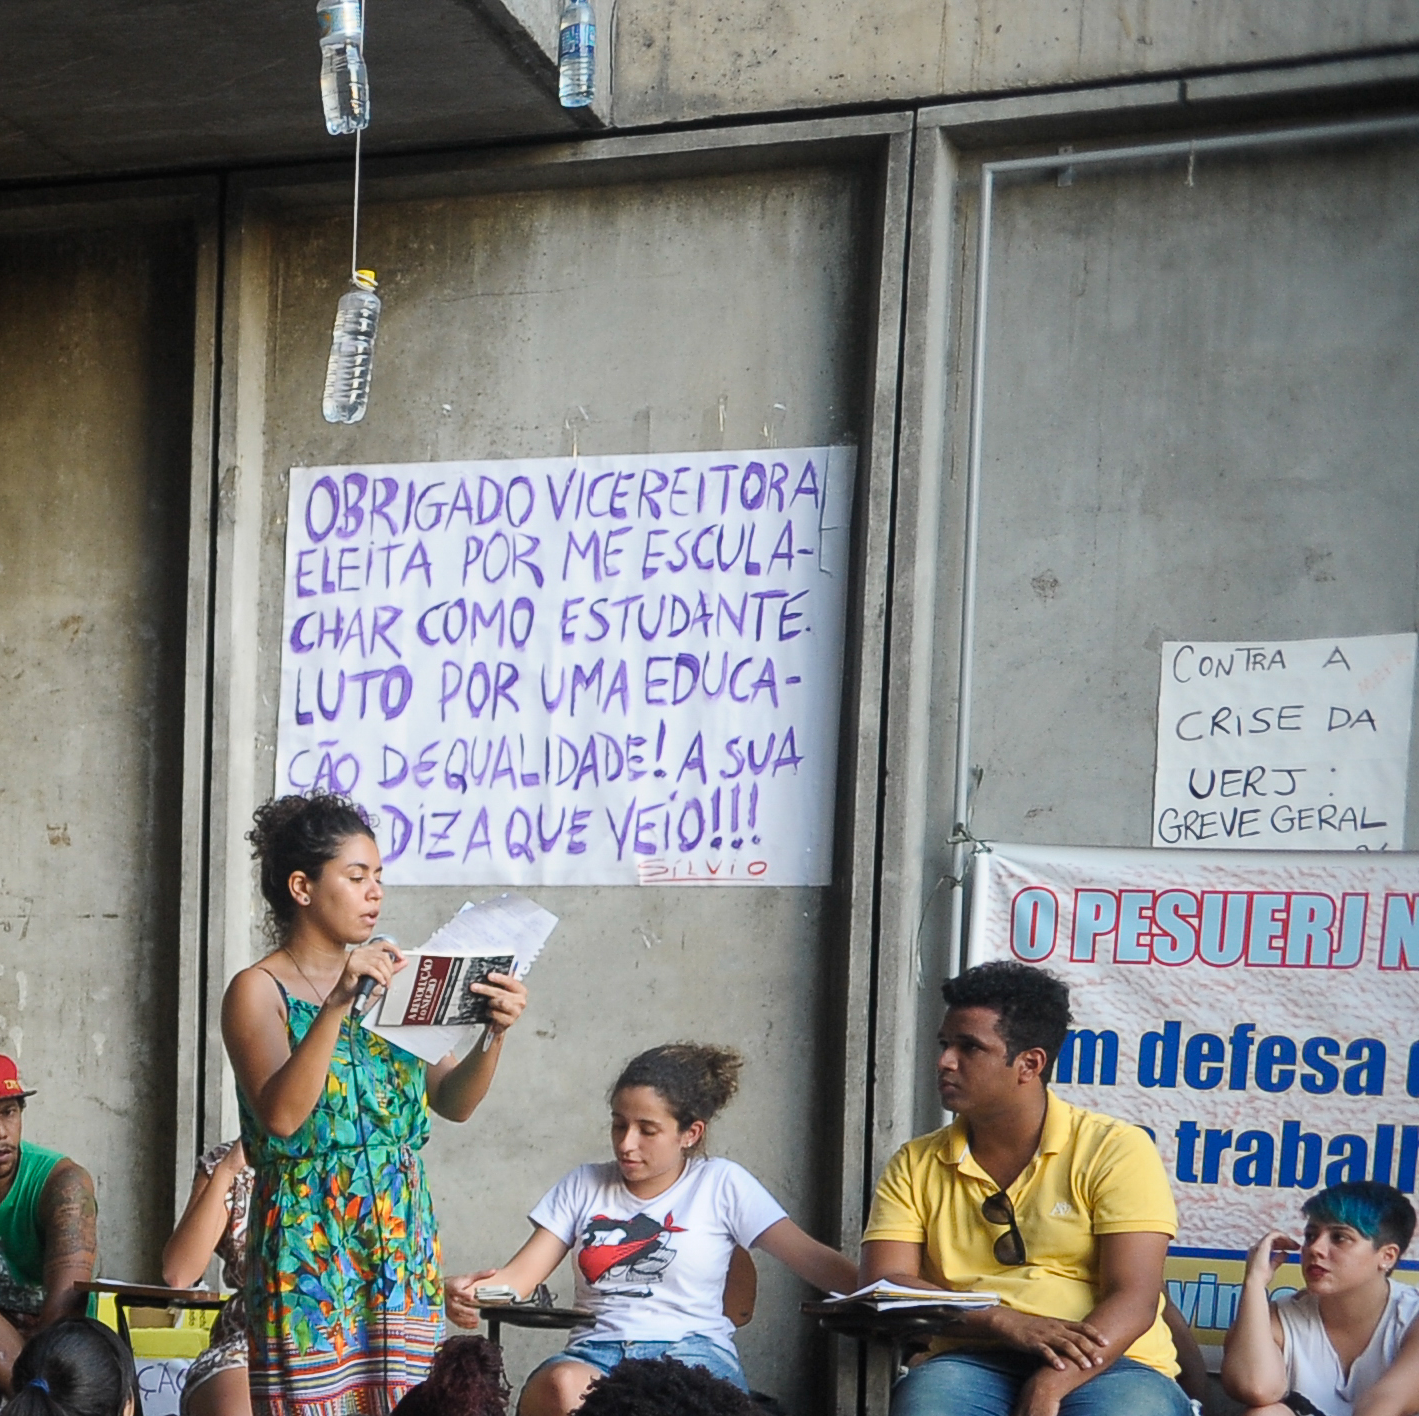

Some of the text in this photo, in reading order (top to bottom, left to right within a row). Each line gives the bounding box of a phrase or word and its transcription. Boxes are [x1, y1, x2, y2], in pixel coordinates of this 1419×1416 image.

[304, 472, 536, 542] OBRIGADO
[296, 536, 433, 600] ELEITA
[463, 533, 544, 588] POR
[563, 528, 634, 583] ME
[289, 604, 403, 658] CHAR
[417, 597, 535, 648] COMO
[294, 664, 413, 726] LUTO
[440, 662, 520, 719] POR
[542, 656, 631, 717] UMA
[1172, 645, 1287, 684] CONTRA
[1322, 645, 1352, 672] A
[1175, 705, 1378, 742] CRISE DA
[676, 729, 708, 785] A
[719, 725, 805, 781] SUA
[1188, 765, 1308, 801] UERJ
[505, 802, 594, 864] QUE
[1158, 804, 1389, 844] GREVE GERAL
[1009, 885, 1059, 963] O
[1068, 887, 1370, 970] PESUERJ
[1137, 1020, 1386, 1096] defesa
